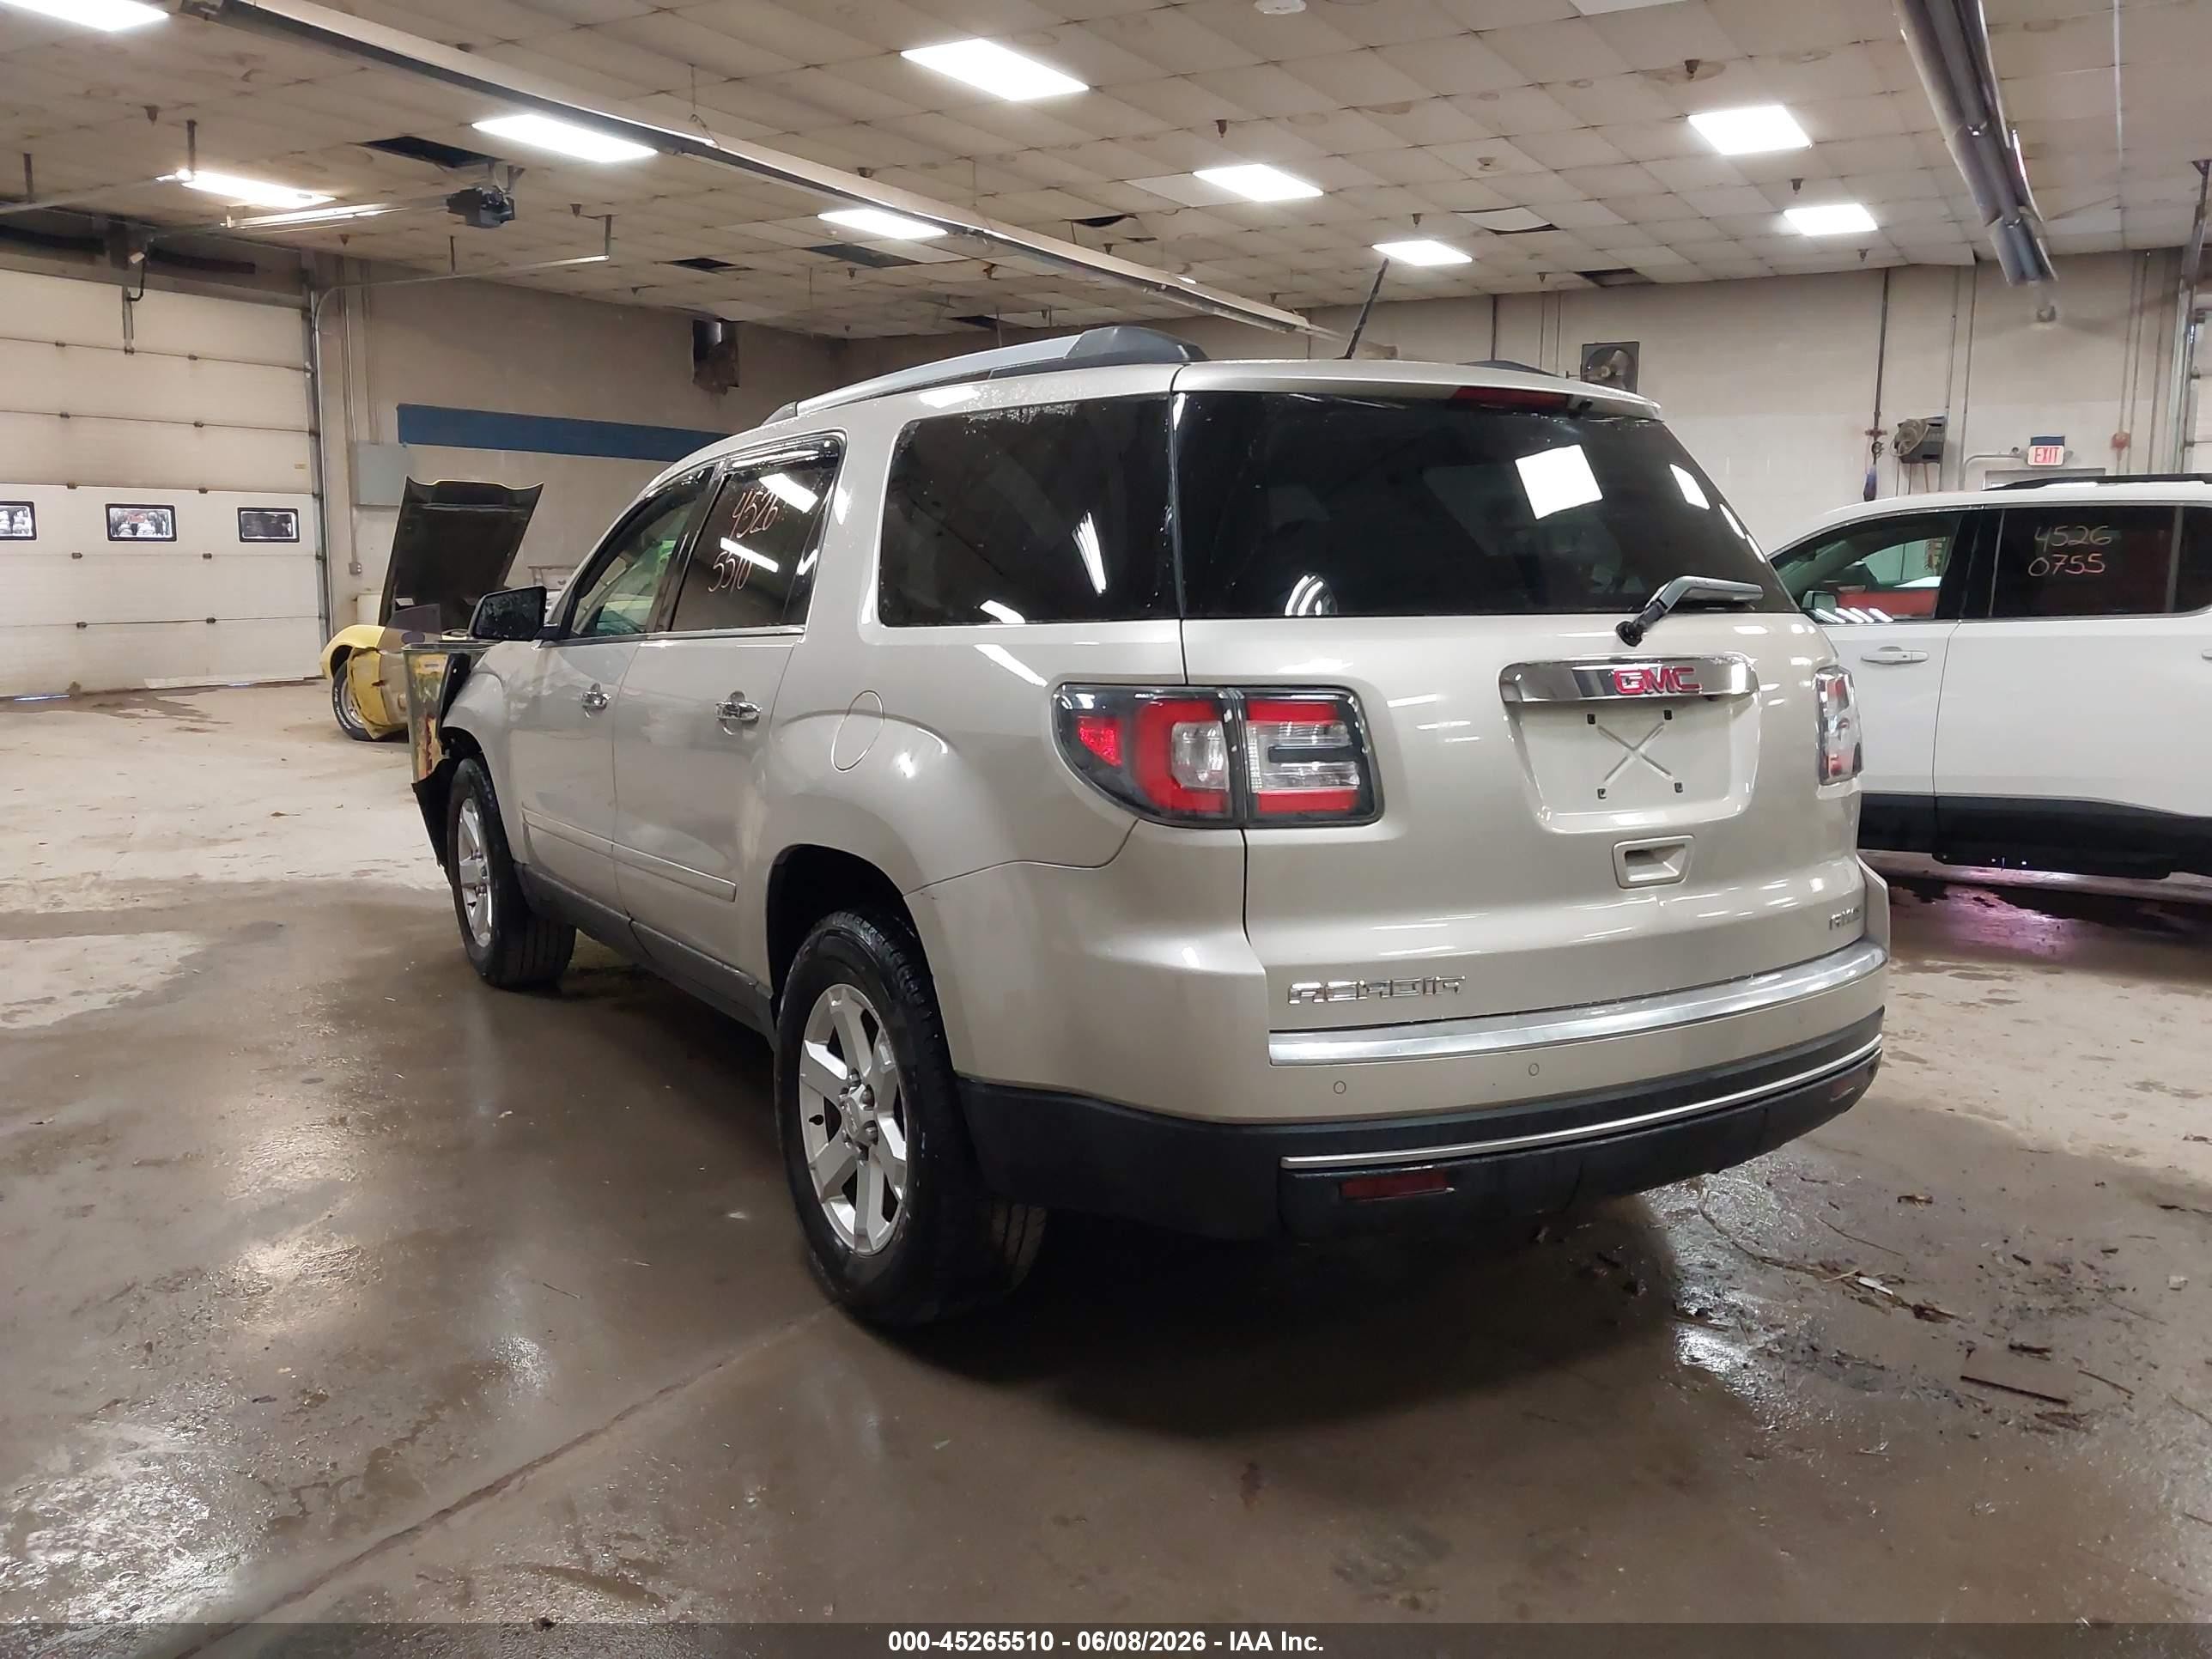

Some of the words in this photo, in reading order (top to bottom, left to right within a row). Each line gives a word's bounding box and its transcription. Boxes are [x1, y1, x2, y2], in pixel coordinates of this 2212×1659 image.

[2033, 447, 2060, 464] EXIT
[732, 488, 779, 539] 4526
[2034, 525, 2112, 552] 4526
[708, 550, 753, 592] 5510
[2027, 553, 2106, 576] 0755
[1613, 665, 1703, 695] GMC
